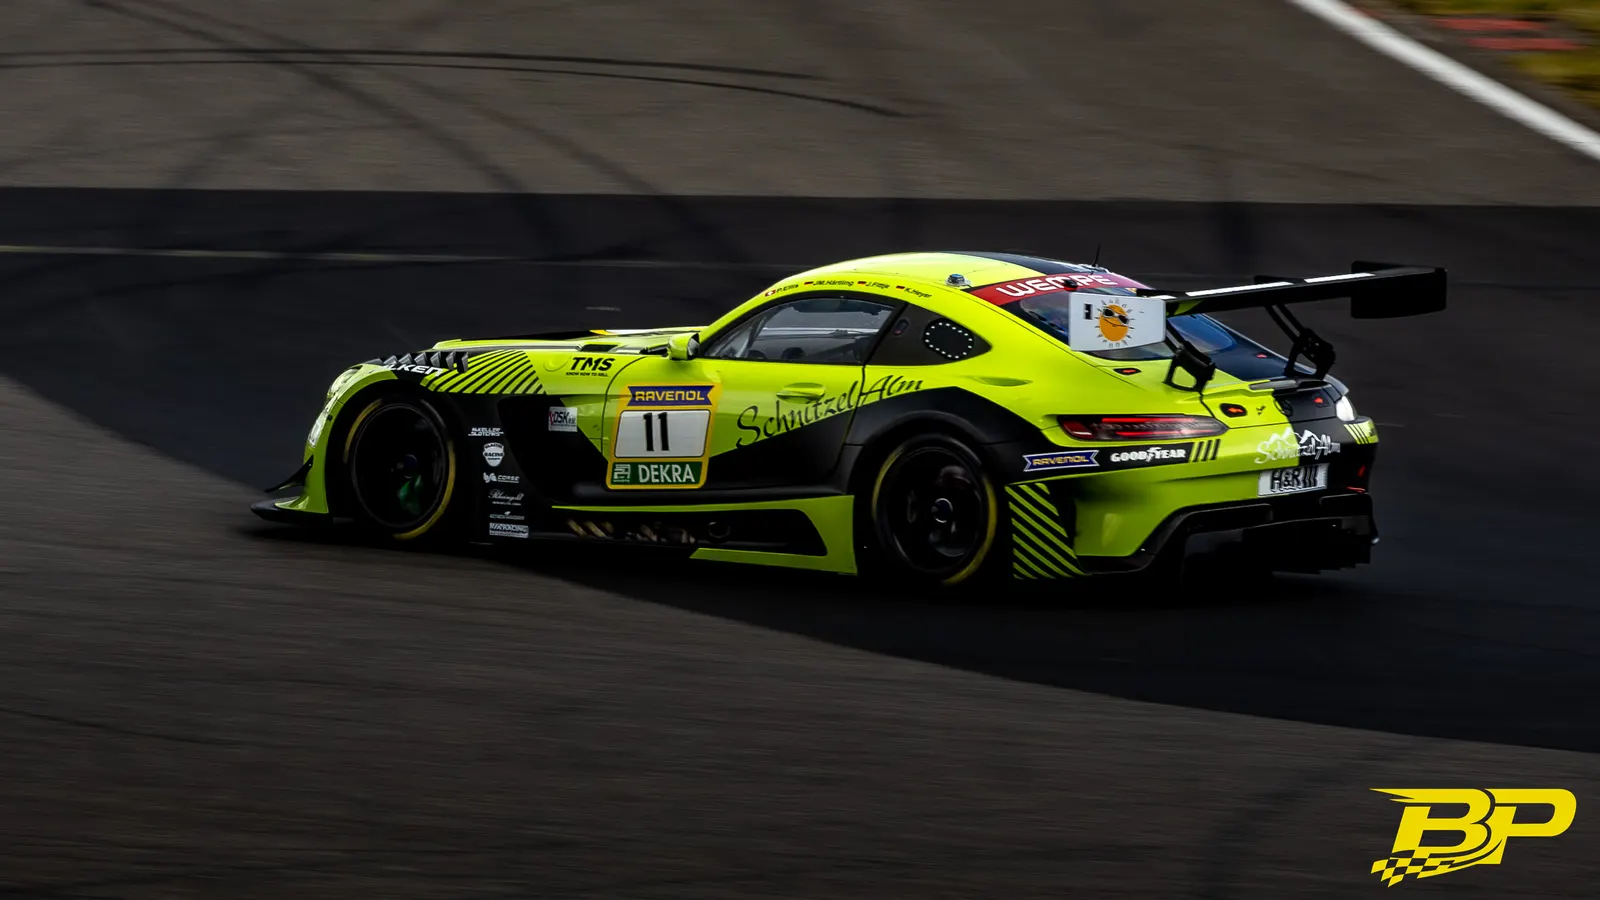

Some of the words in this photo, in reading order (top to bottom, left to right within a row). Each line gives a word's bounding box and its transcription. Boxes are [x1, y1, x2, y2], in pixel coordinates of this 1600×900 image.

[996, 273, 1118, 297] WEMPE
[571, 357, 615, 371] TMS
[635, 391, 705, 401] RAVENOL
[735, 380, 858, 447] Schnitzel
[858, 375, 924, 406] Alm
[643, 412, 669, 452] 11
[1032, 455, 1089, 466] RAVENOL
[1110, 447, 1186, 462] GOODYEAR
[638, 464, 696, 483] DEKRA
